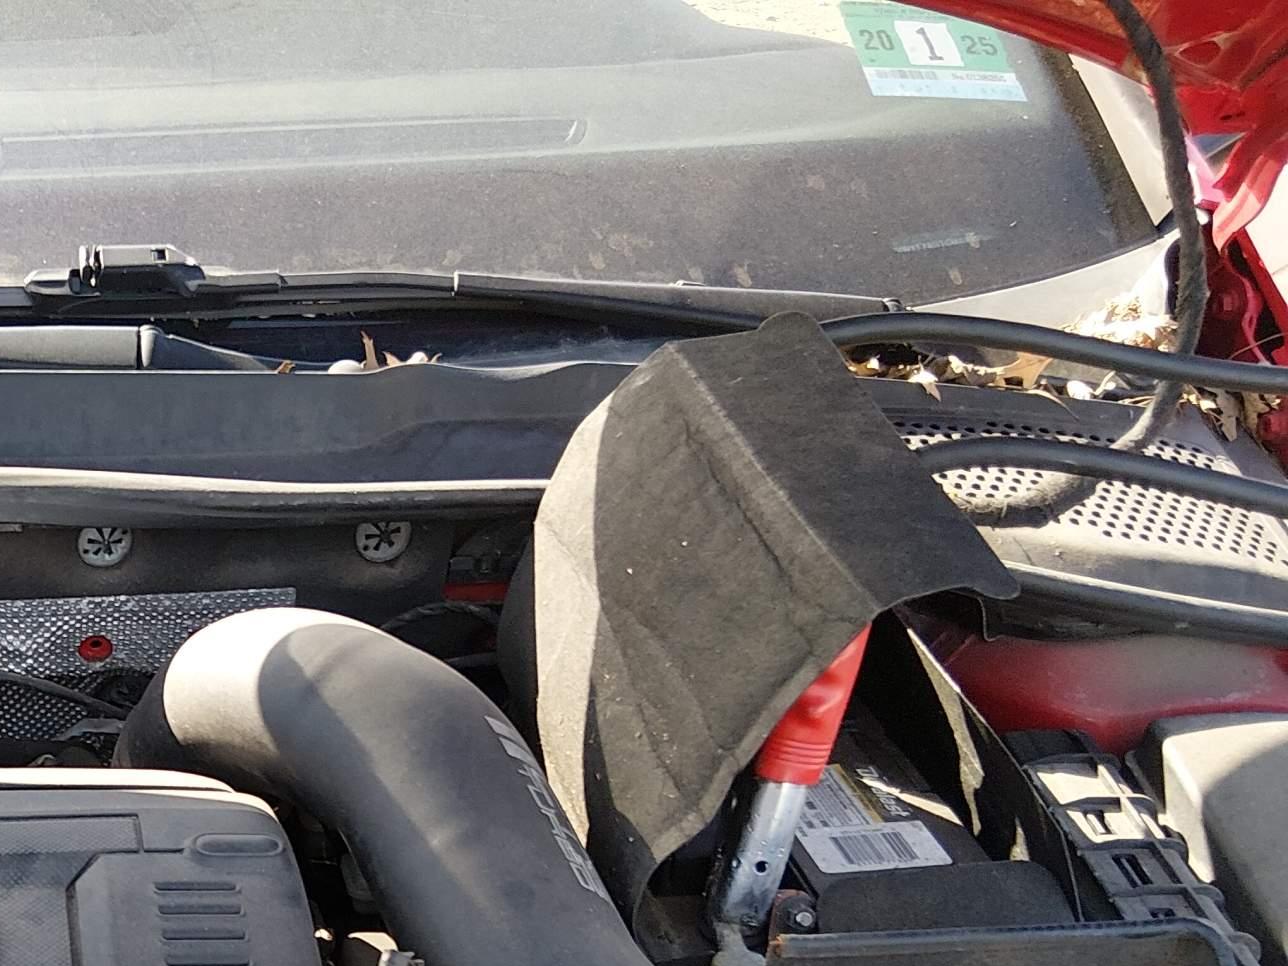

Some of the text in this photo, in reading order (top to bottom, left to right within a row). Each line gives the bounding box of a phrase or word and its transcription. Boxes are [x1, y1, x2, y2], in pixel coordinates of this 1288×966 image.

[859, 27, 998, 61] 20 1 25
